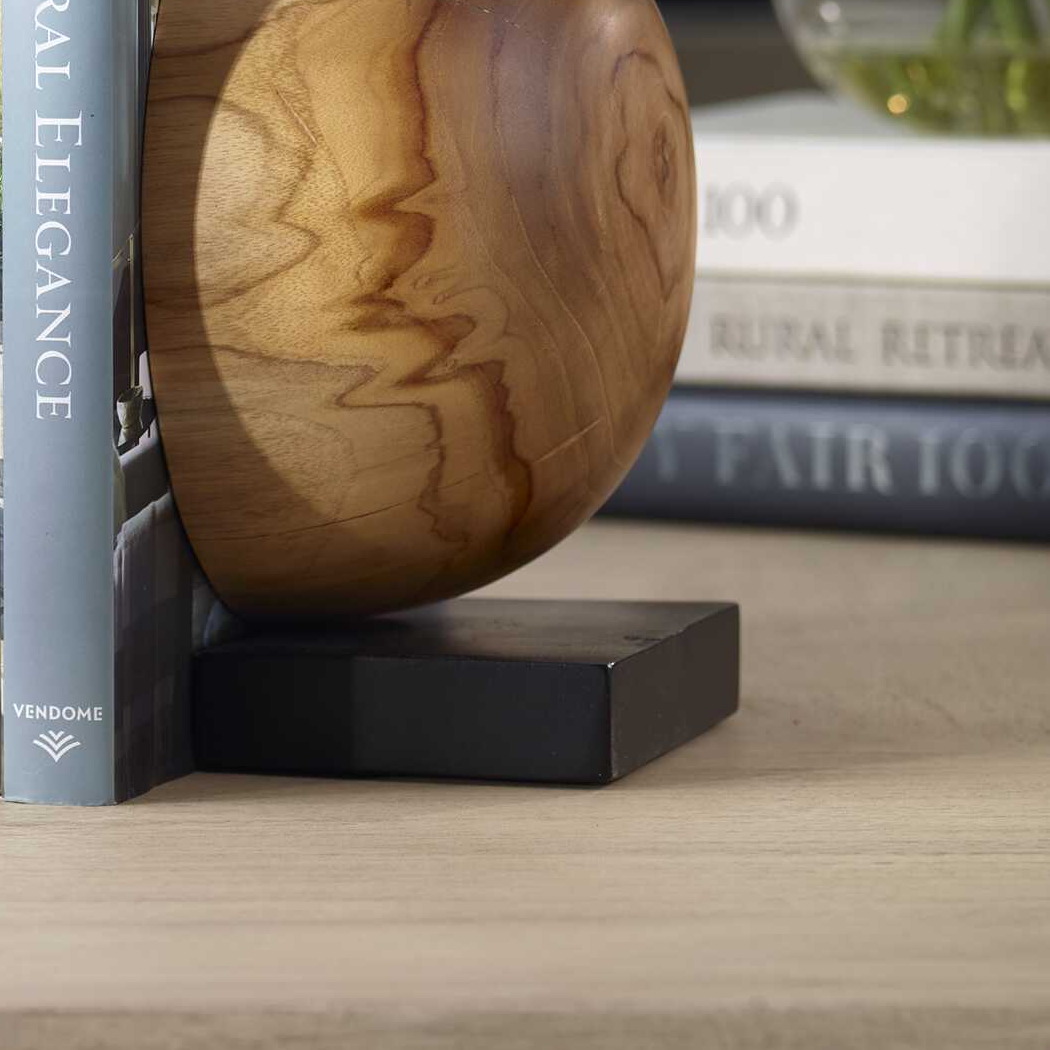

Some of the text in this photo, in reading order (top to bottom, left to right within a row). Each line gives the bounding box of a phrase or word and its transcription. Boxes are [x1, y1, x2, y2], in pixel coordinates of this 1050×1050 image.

[34, 109, 83, 421] ELEGANCE
[708, 311, 857, 364] RURAL
[714, 419, 893, 497] FAIR
[12, 702, 103, 722] VENDOME
